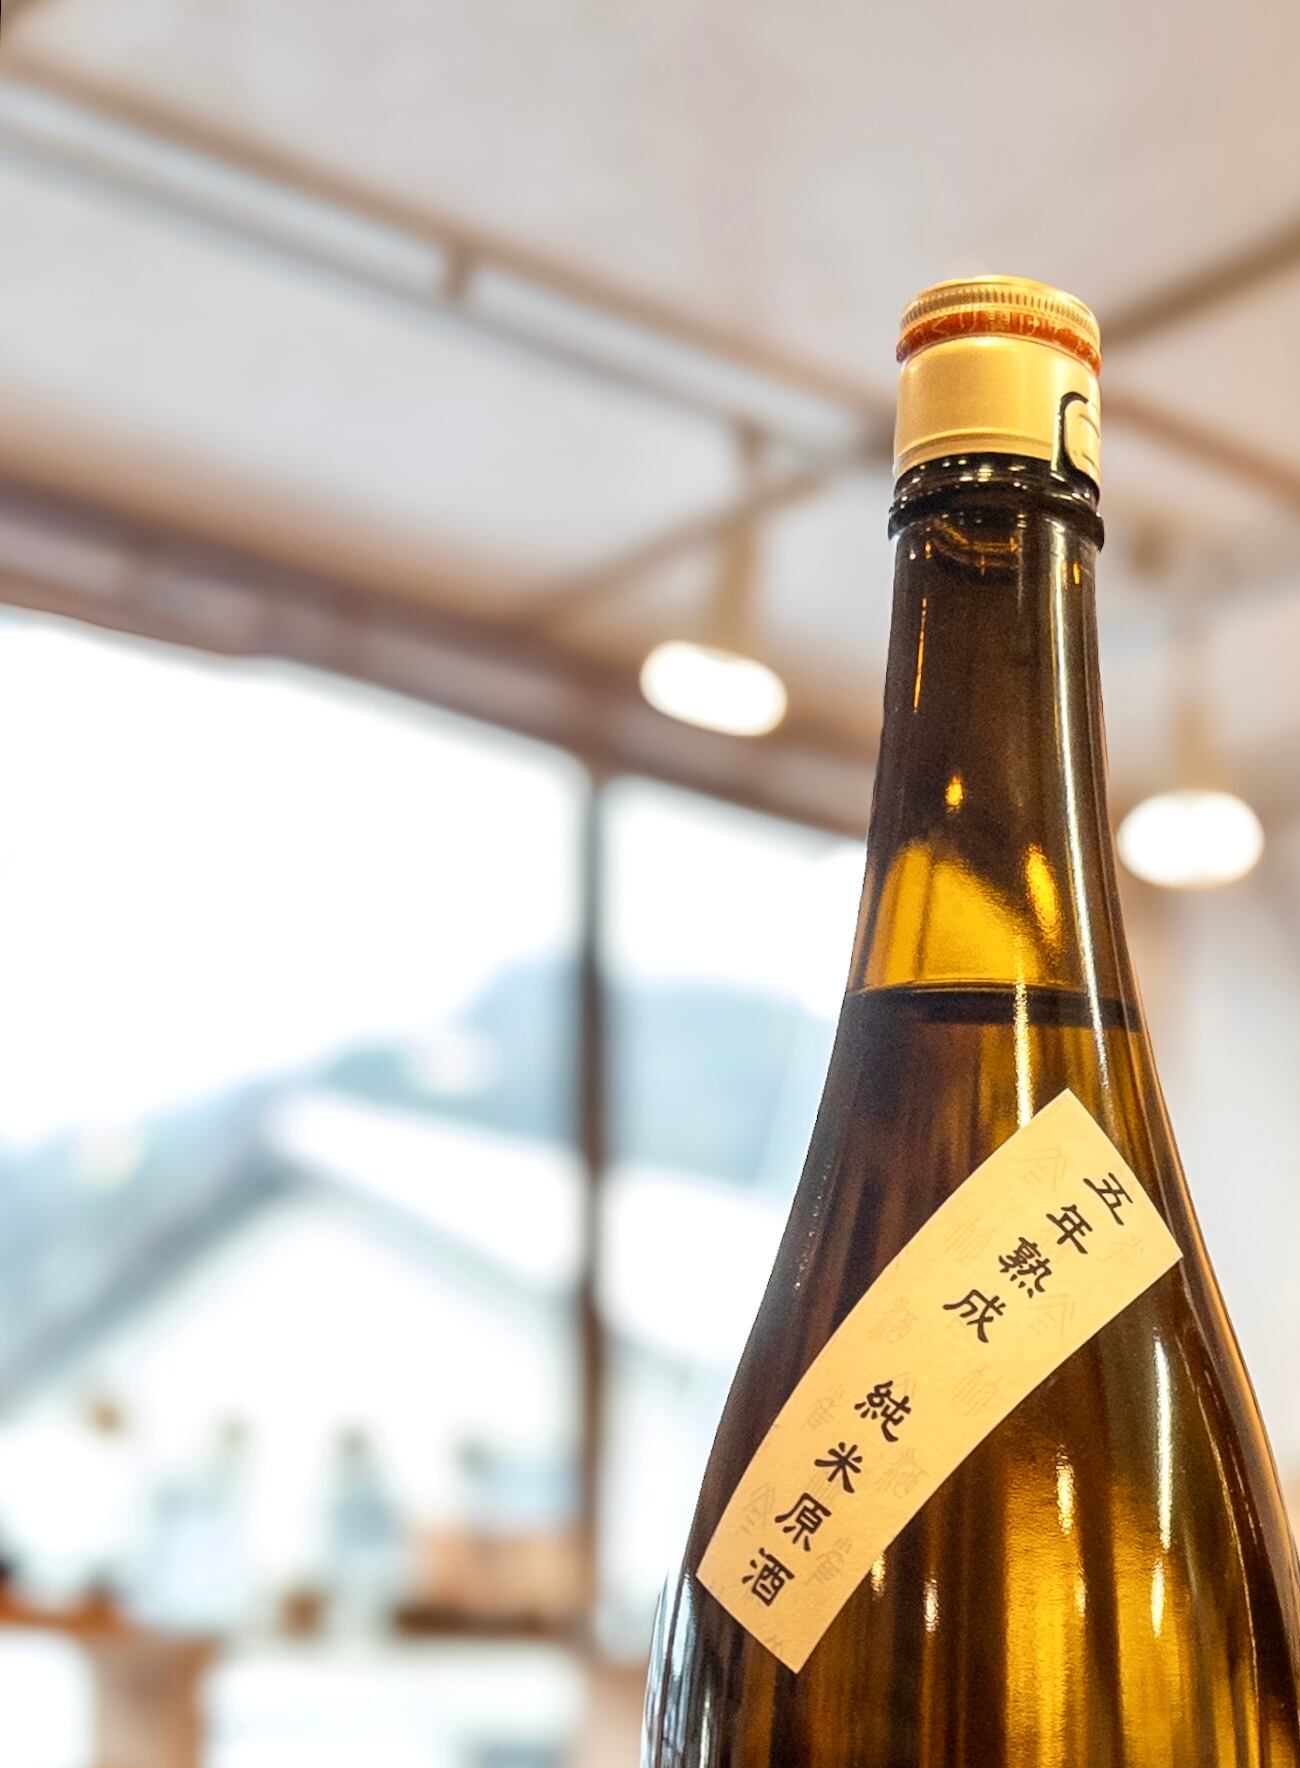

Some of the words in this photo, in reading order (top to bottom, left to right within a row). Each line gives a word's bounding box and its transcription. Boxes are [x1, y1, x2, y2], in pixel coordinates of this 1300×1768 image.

[942, 1172, 1134, 1343] 五年熟成
[741, 1380, 912, 1607] 純米原酒
